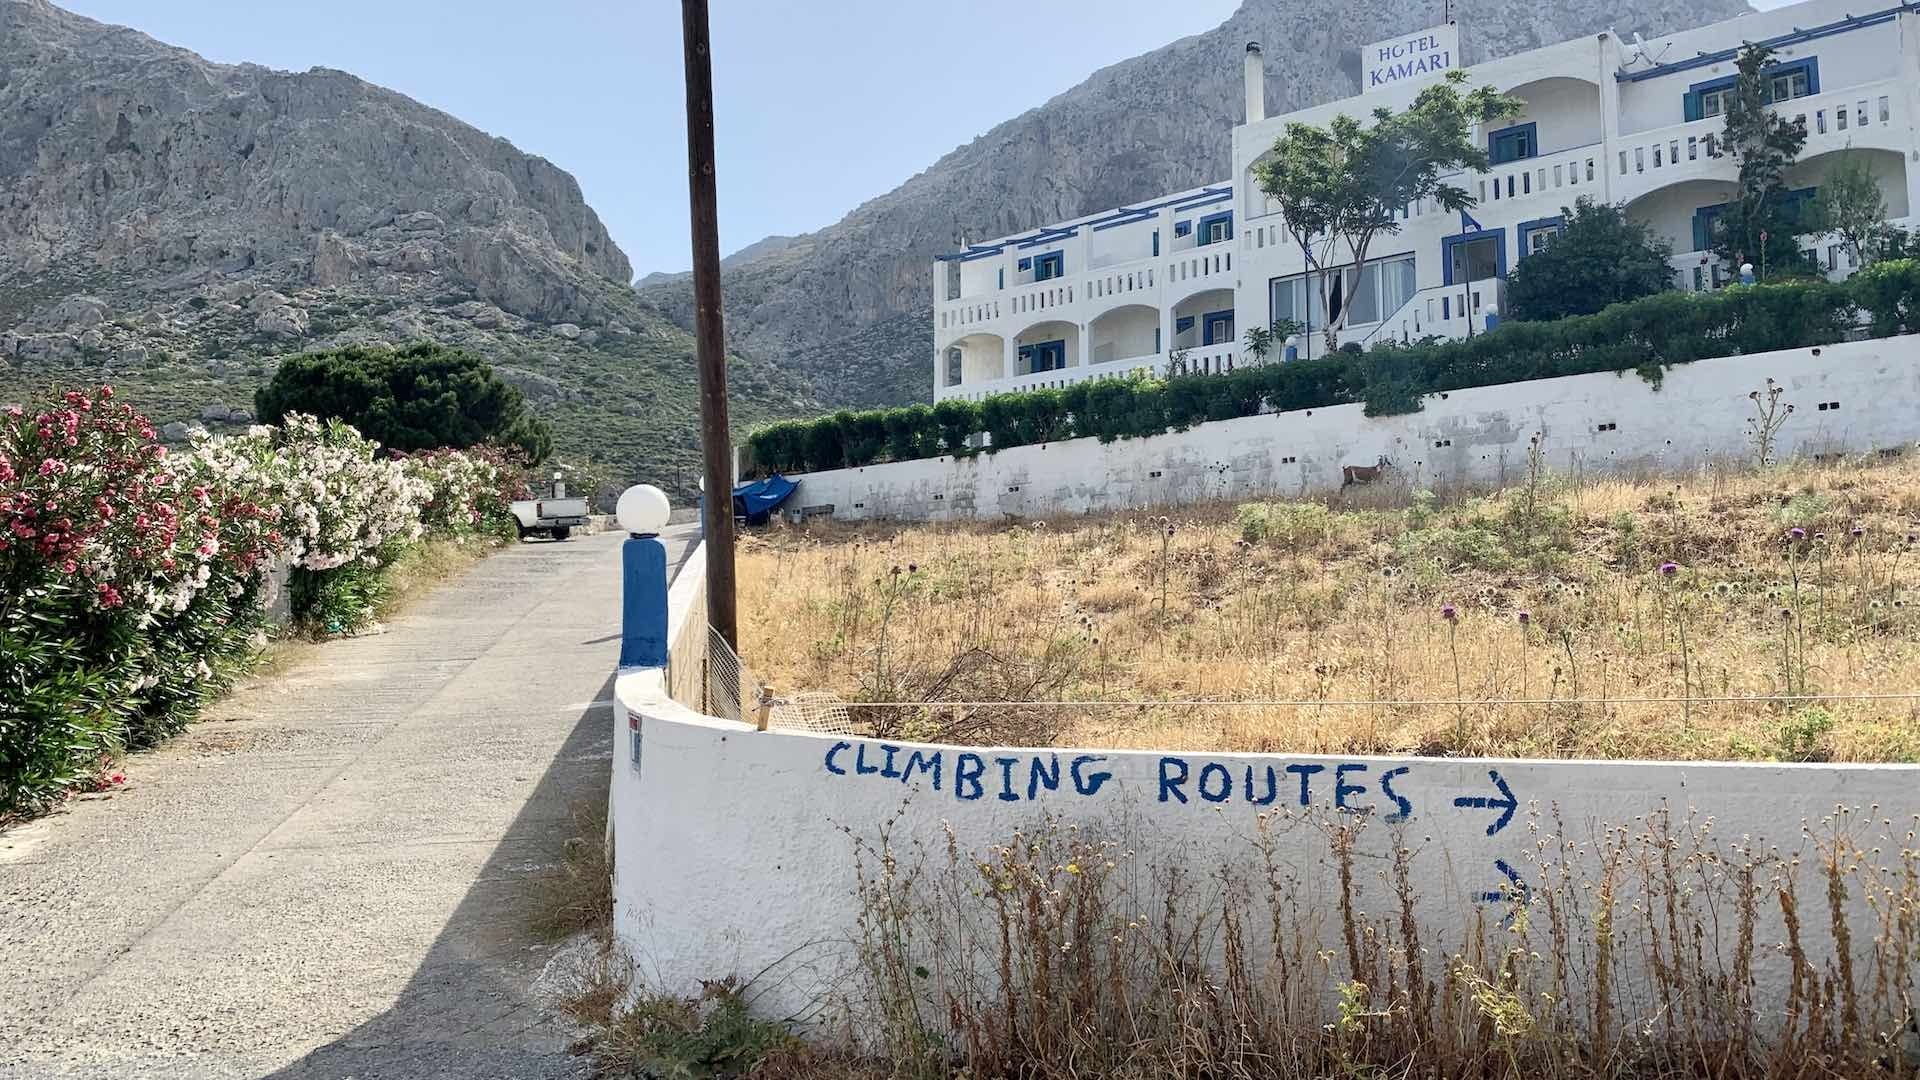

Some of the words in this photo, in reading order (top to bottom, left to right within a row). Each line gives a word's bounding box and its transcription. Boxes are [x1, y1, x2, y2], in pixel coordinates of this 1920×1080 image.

[1379, 36, 1439, 61] HOTEL
[1370, 51, 1450, 86] KAMARI
[825, 740, 1113, 802] CLIMBING
[1158, 756, 1412, 822] ROUTES
